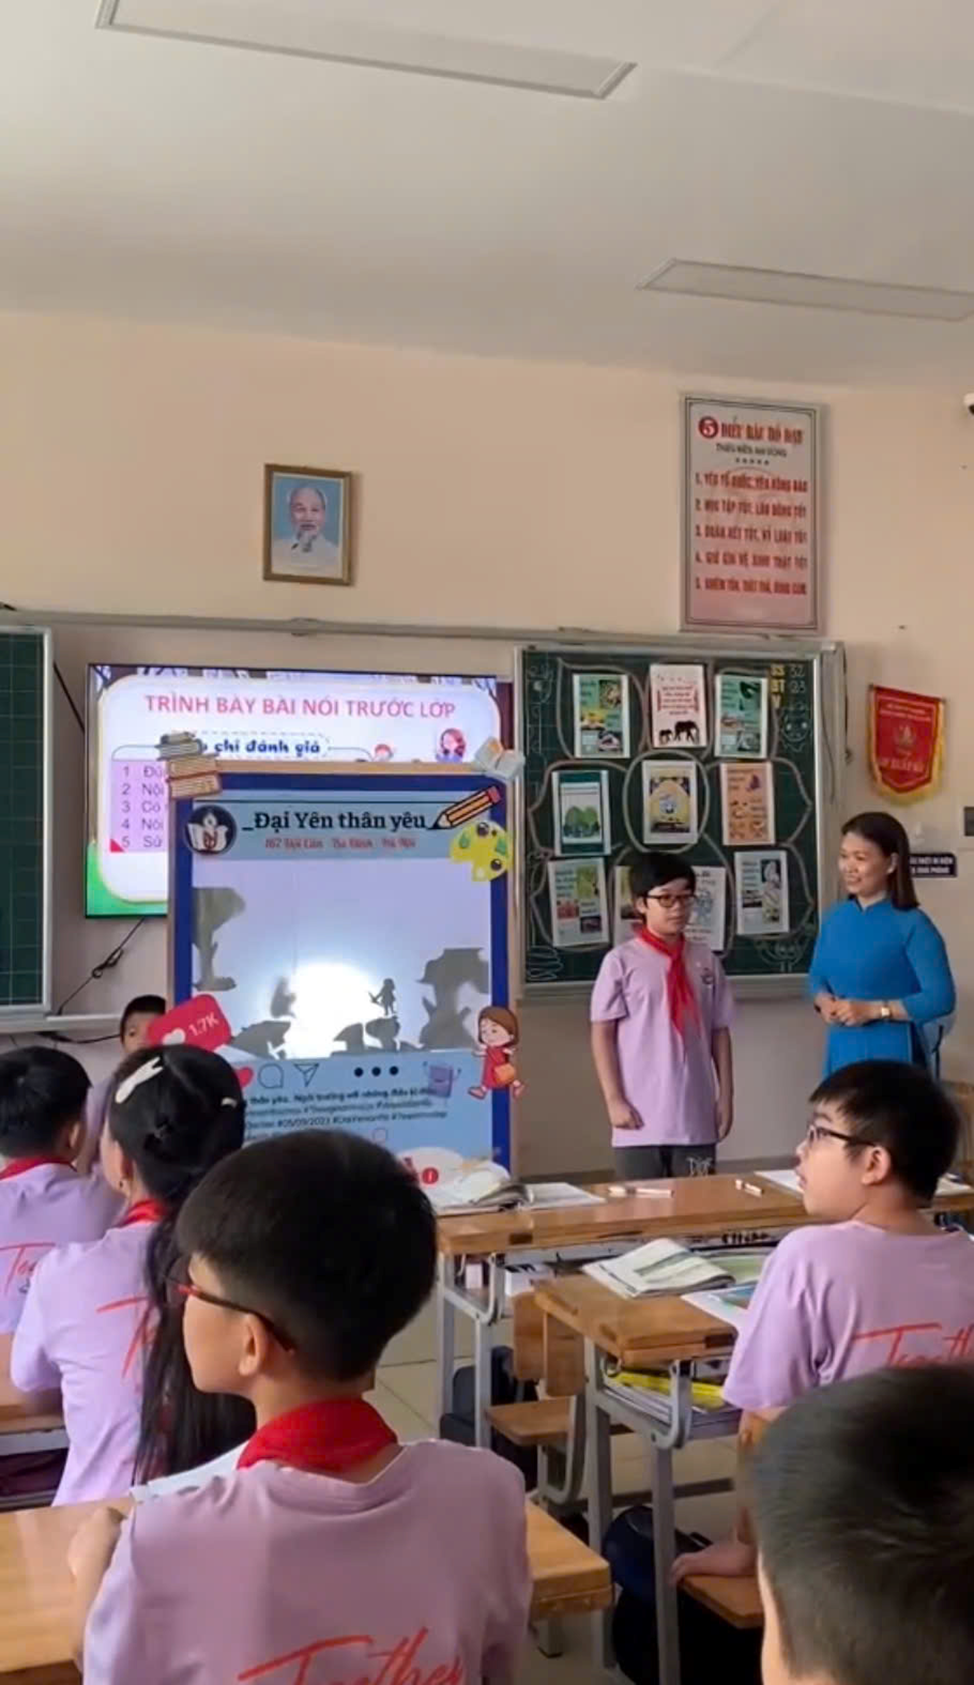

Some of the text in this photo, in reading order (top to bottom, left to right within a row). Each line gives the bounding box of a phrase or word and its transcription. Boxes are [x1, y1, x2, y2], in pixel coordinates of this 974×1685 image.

[702, 418, 716, 437] 5
[145, 693, 456, 719] TRÌNH BÀY BÀI NÓI TRƯỚC LỚP
[123, 766, 130, 777] 1
[122, 783, 131, 795] 2
[121, 800, 131, 813] 3
[121, 818, 130, 829] 4
[294, 812, 334, 829] Yên
[338, 811, 386, 829] thân
[122, 836, 130, 848] 5
[189, 1010, 220, 1037] 1.7K
